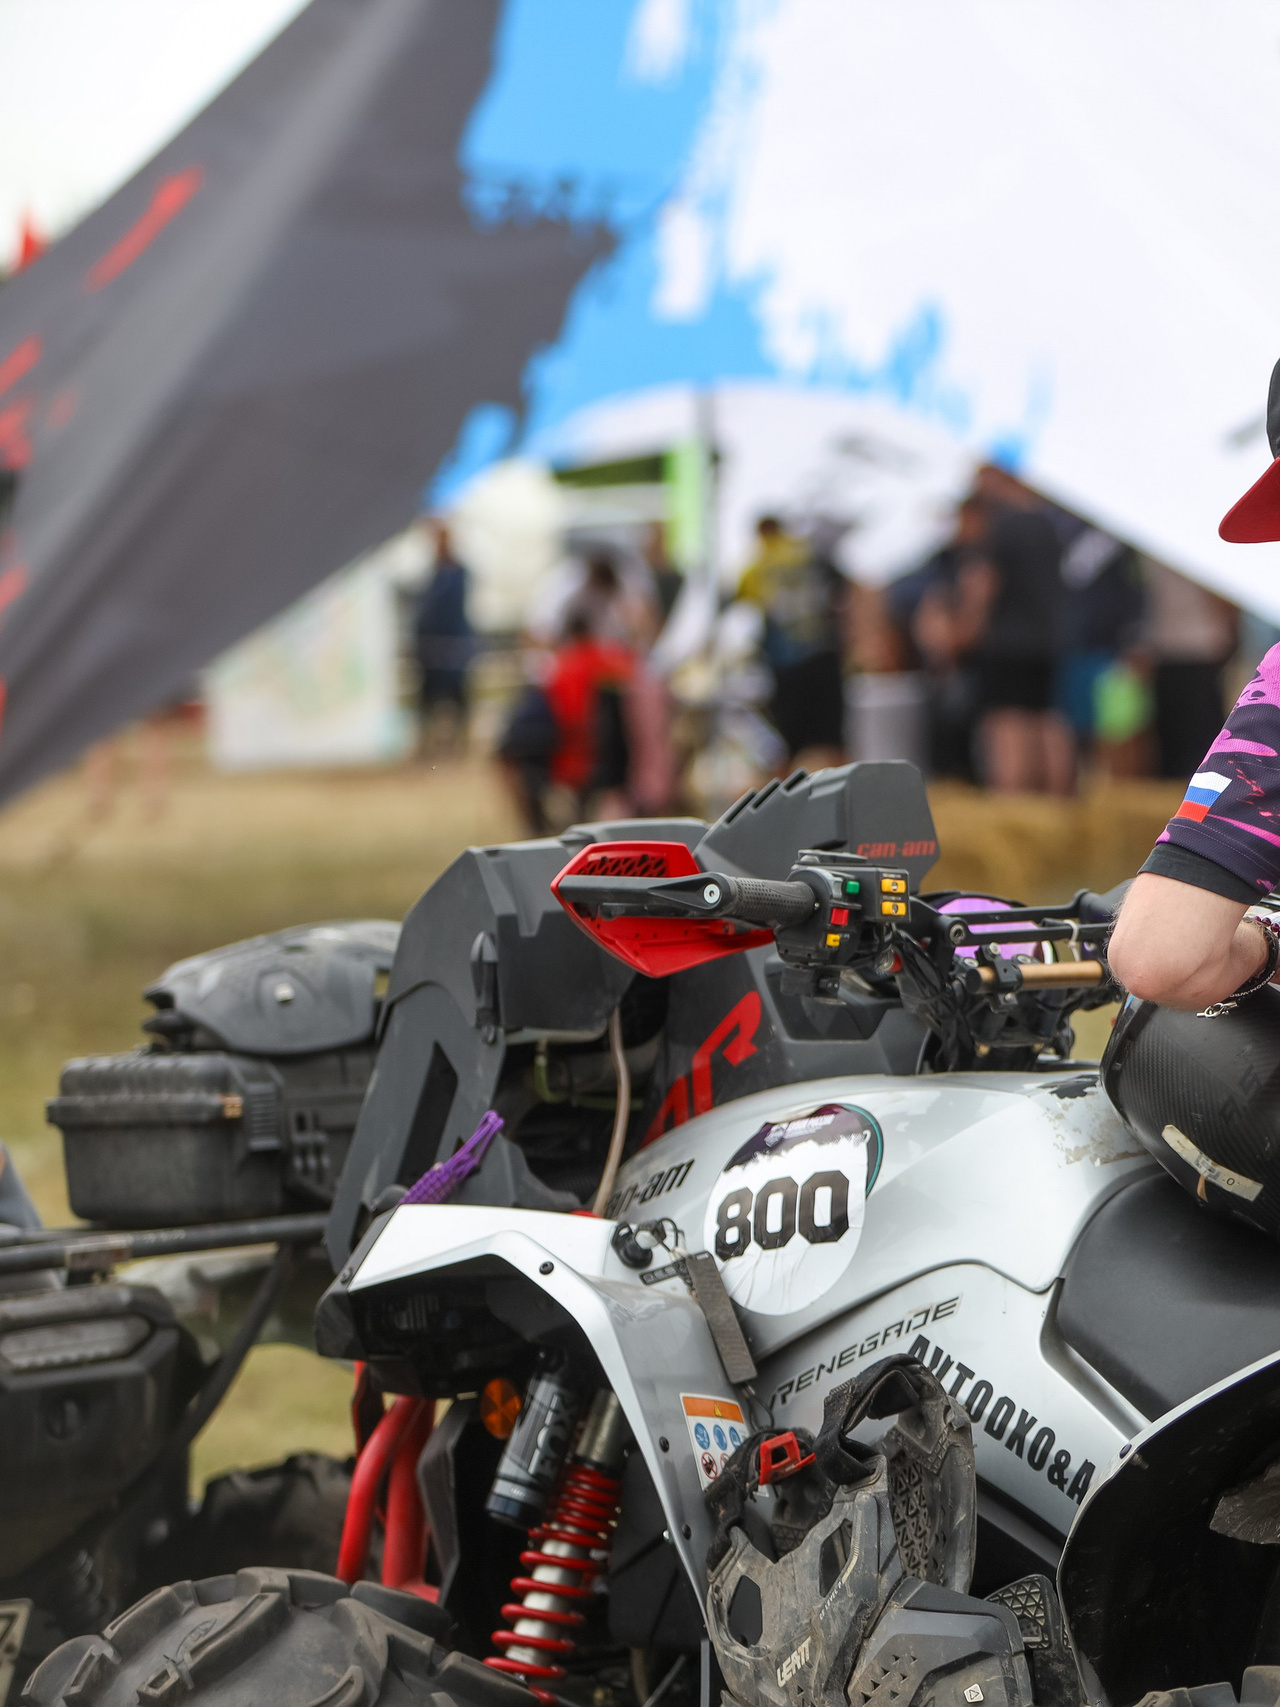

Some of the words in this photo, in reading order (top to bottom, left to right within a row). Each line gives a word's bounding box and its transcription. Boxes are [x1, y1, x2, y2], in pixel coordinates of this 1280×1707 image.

[857, 840, 936, 858] can-am
[605, 1158, 695, 1218] an-am
[715, 1170, 850, 1262] 800
[769, 1296, 960, 1410] RENEGADE
